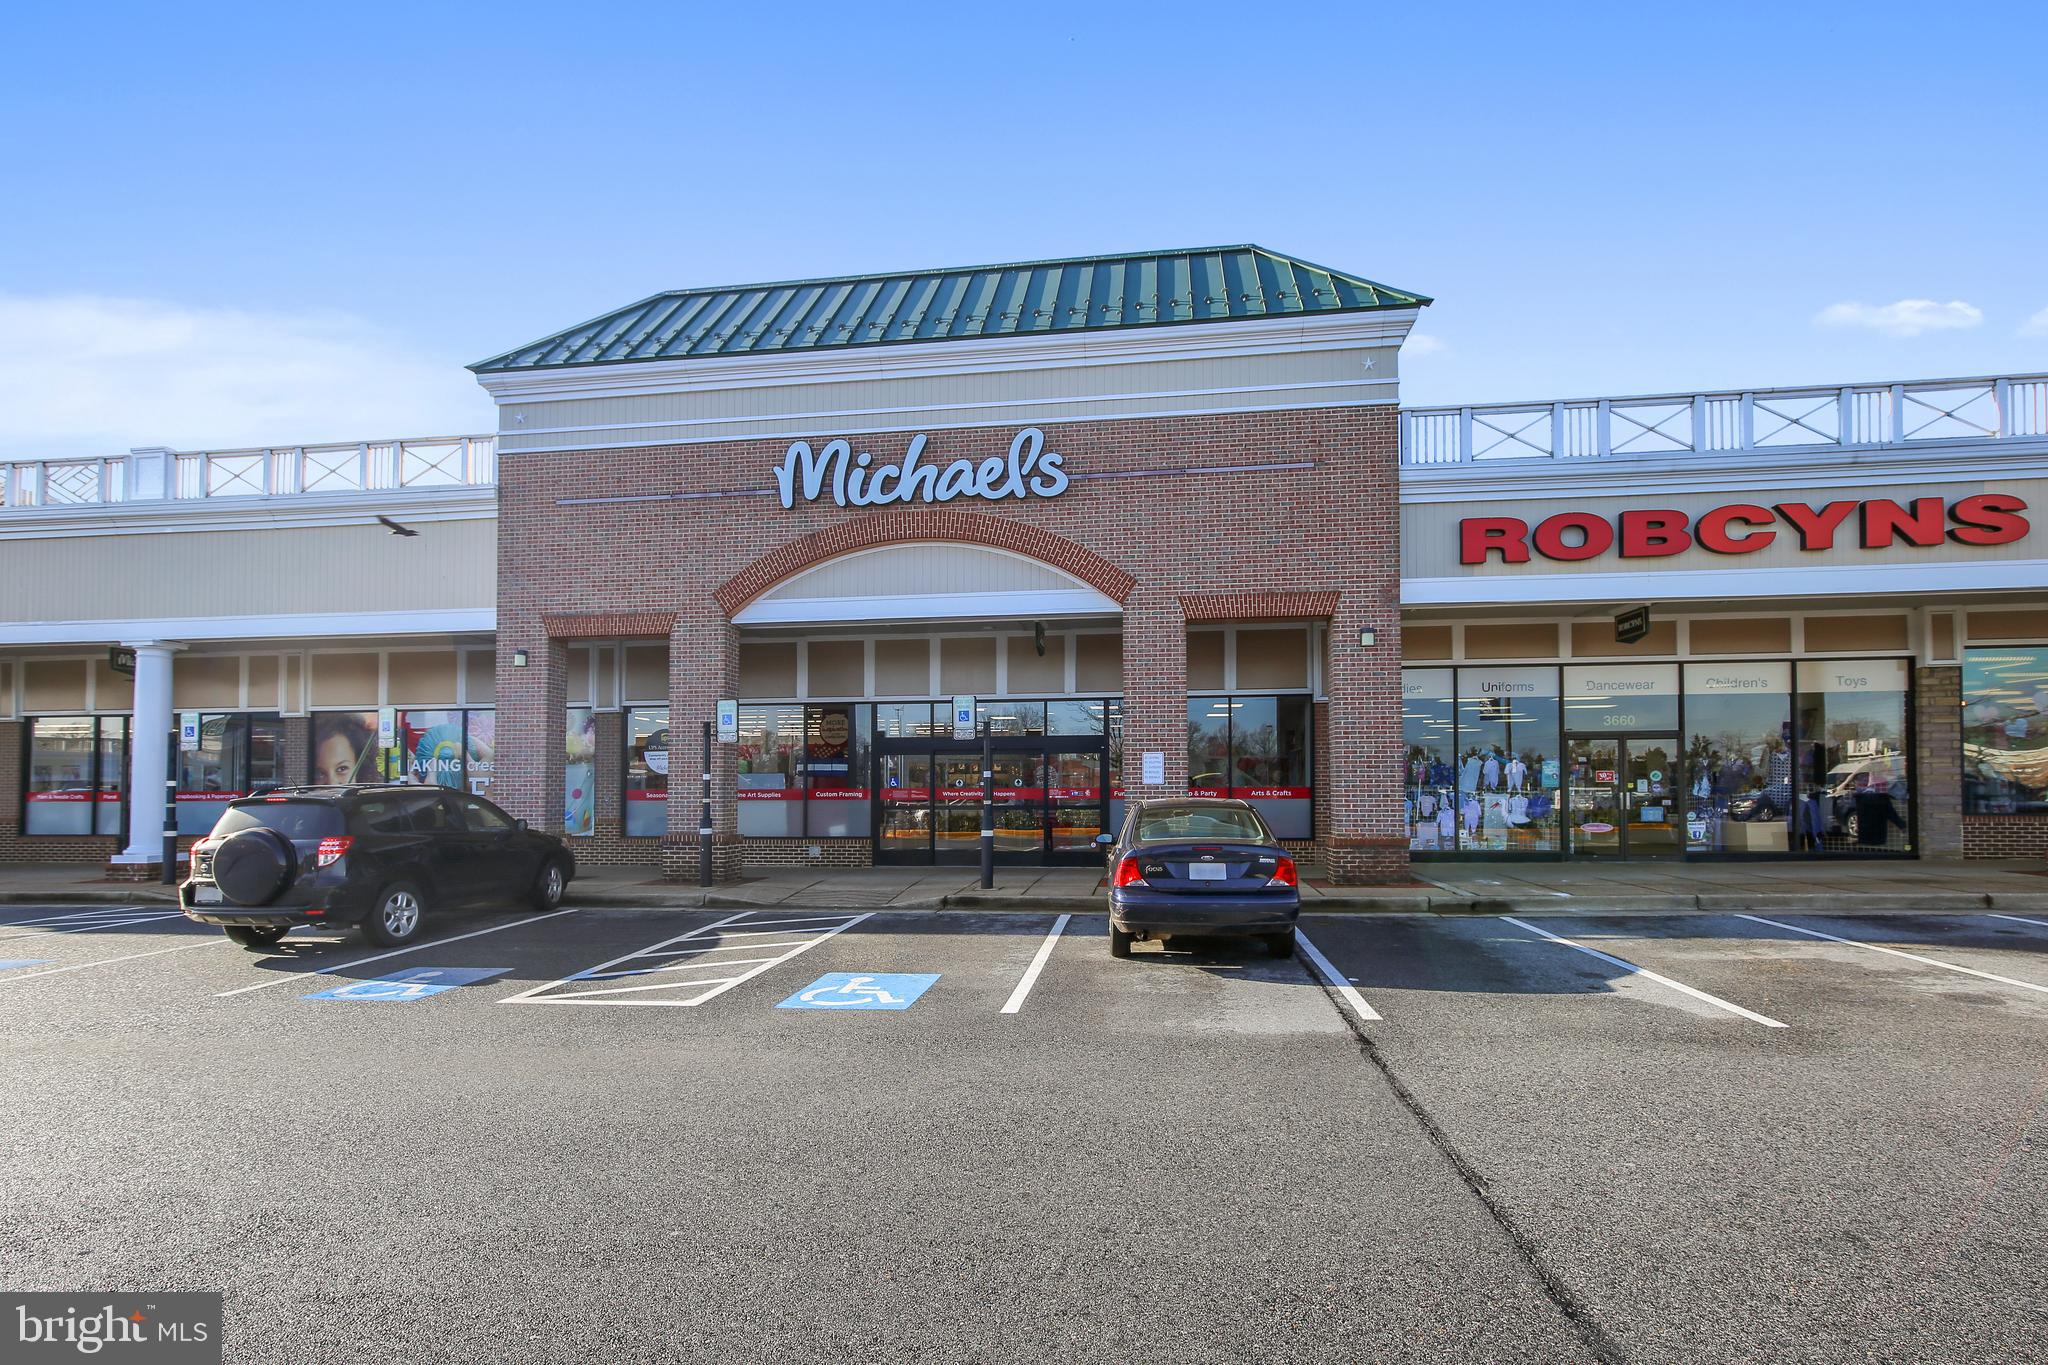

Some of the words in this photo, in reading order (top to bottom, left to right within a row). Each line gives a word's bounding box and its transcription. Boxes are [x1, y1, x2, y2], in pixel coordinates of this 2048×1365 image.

[773, 427, 1069, 508] Michaels
[1459, 493, 2031, 565] ROBCYNS
[1481, 681, 1535, 693] Uniforms
[1586, 680, 1656, 691] Dancewear
[1706, 677, 1768, 689] Children's
[1836, 675, 1868, 688] Toys
[1603, 715, 1636, 726] 3660
[466, 760, 495, 772] crea
